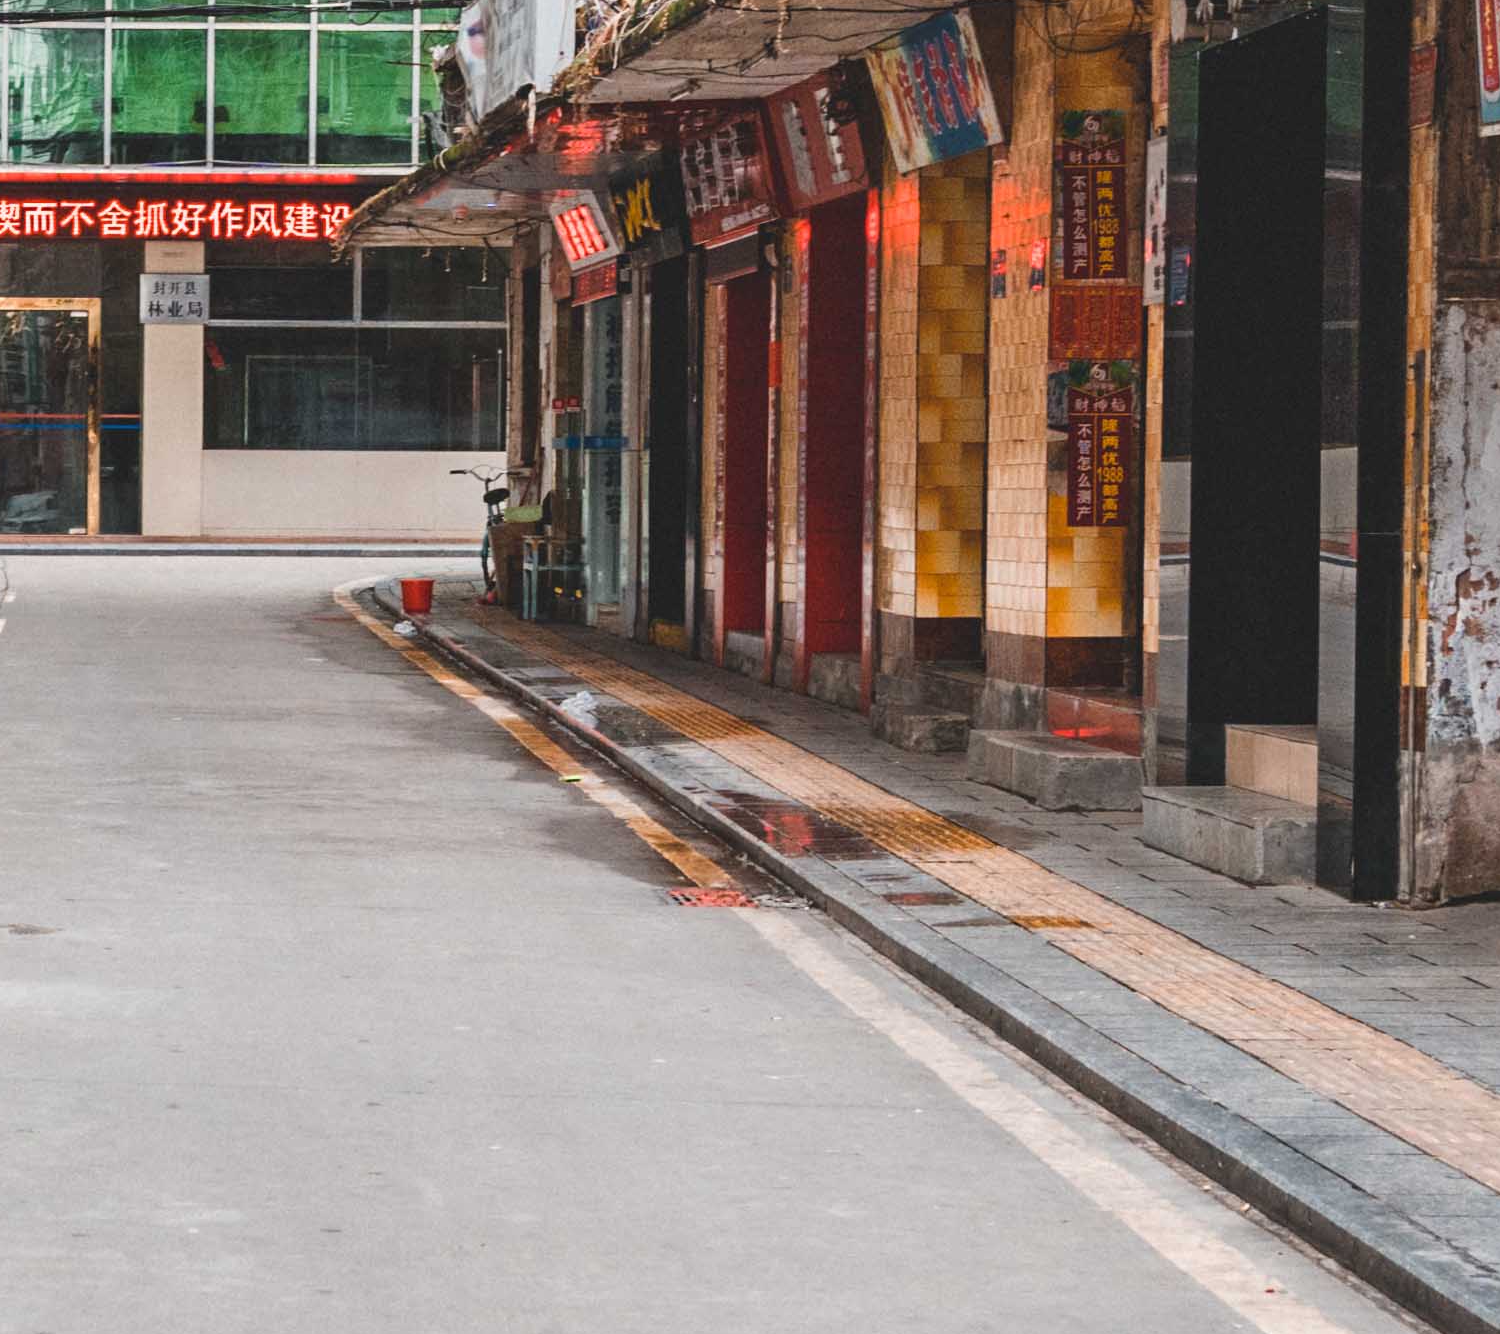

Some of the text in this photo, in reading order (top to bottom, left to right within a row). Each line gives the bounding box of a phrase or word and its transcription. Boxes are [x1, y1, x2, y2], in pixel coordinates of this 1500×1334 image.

[152, 280, 198, 296] 封开县
[147, 299, 204, 319] 林业局
